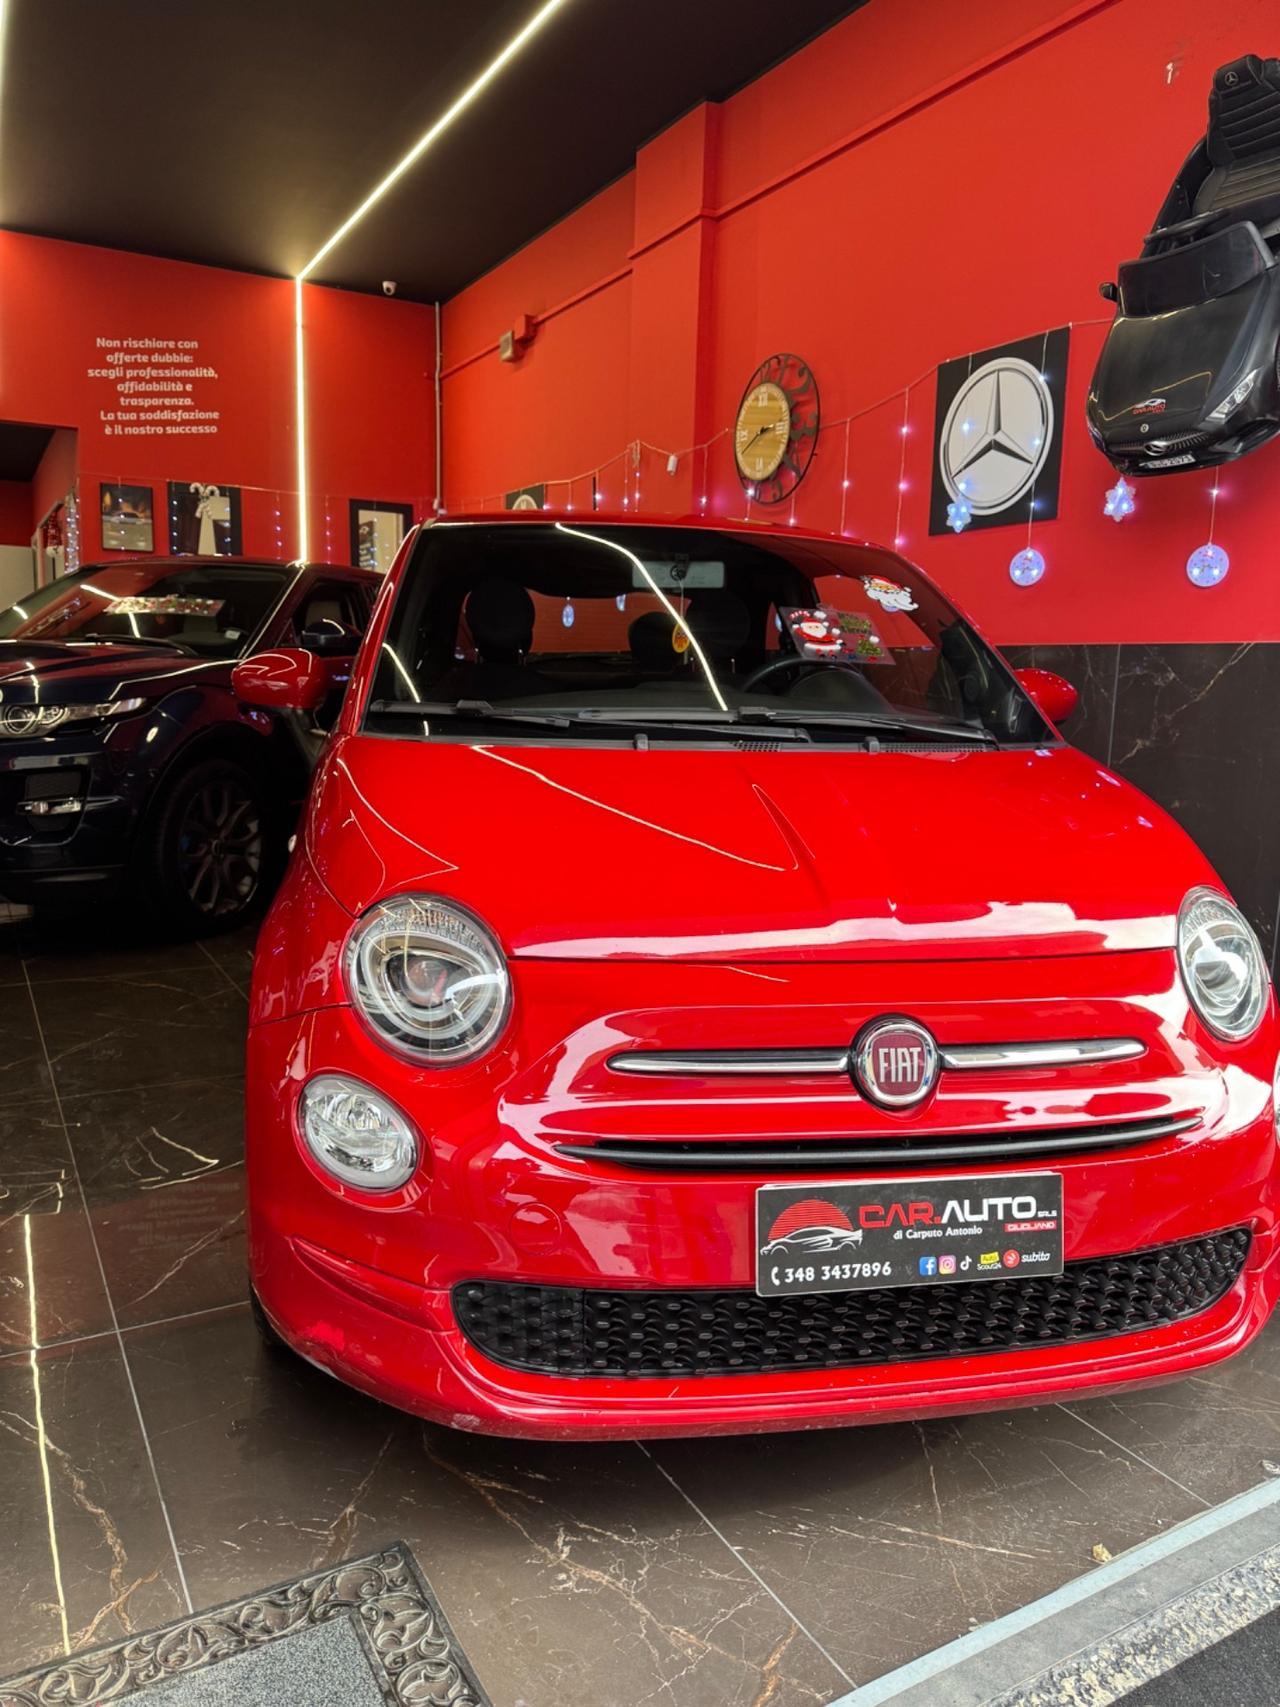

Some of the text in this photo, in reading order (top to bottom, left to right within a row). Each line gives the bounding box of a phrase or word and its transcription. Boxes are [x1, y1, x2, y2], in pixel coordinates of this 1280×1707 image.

[96, 337, 198, 349] Non rischiare con
[106, 352, 193, 365] offerte dubbie:
[87, 366, 123, 379] scegli
[117, 381, 192, 394] affidabilità e
[120, 396, 194, 408] trasparenza.
[100, 410, 219, 422] La tua soddisfazione
[104, 424, 217, 435] è il nostro successo
[878, 1047, 921, 1083] FIAT
[893, 1225, 983, 1241] di Carputo Antonio
[1021, 1250, 1051, 1263] subito
[784, 1262, 892, 1283] 348 3437896
